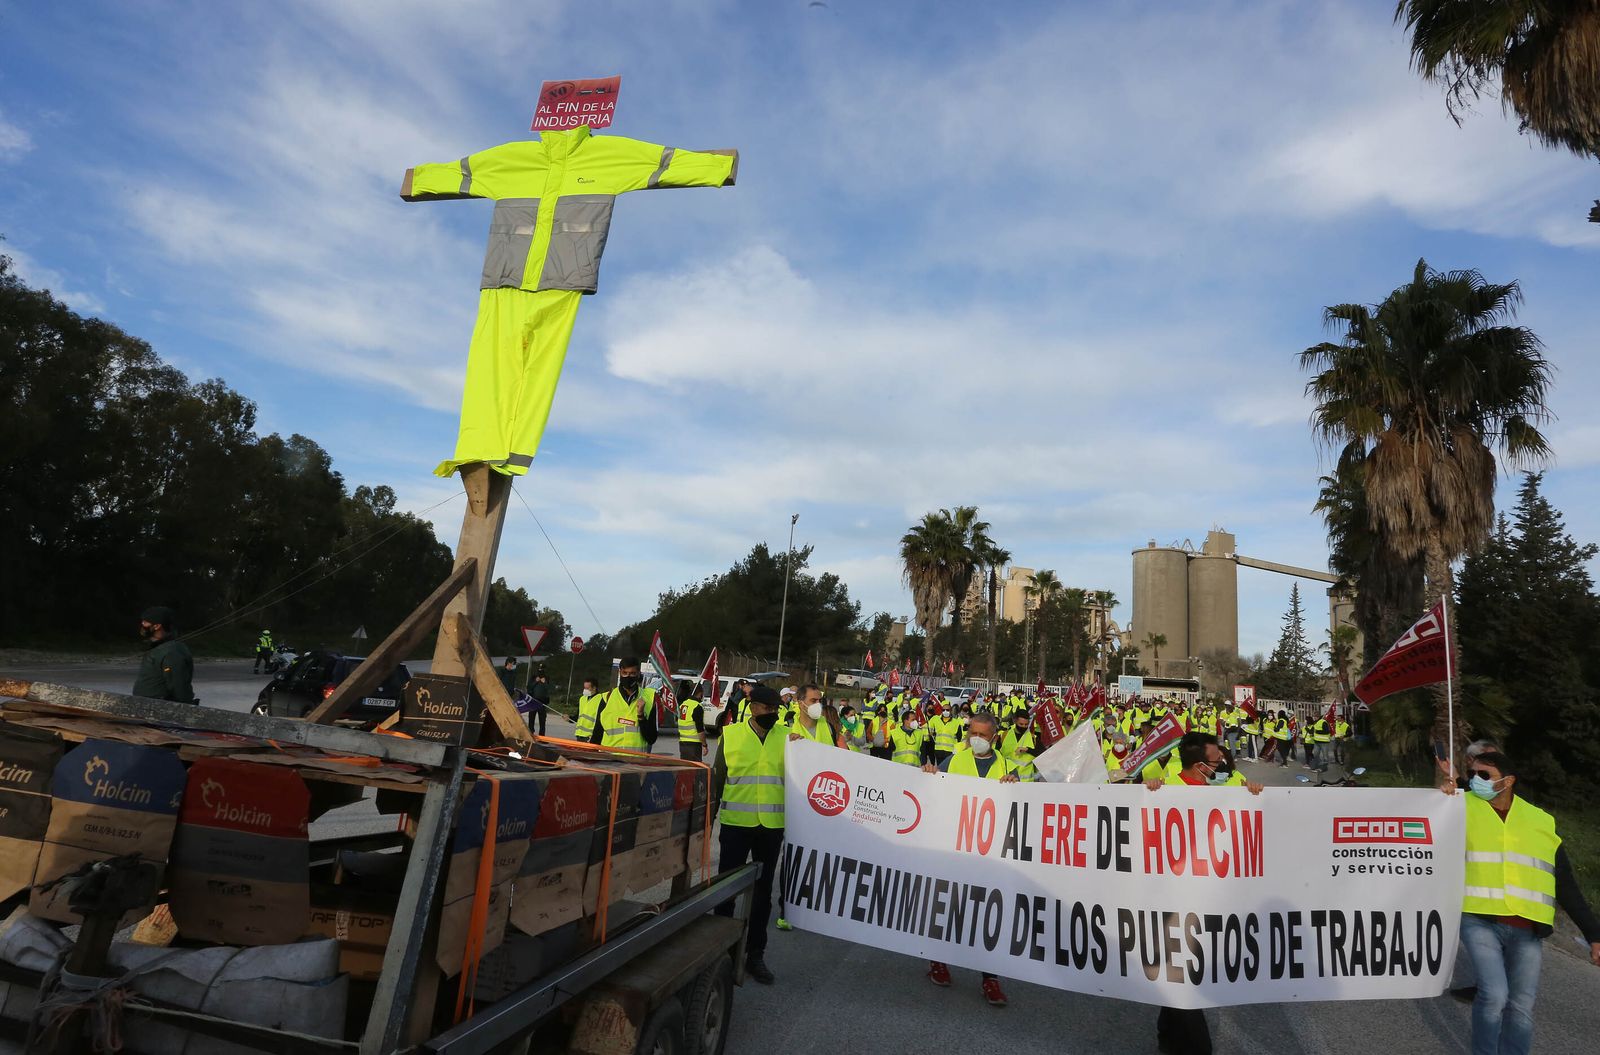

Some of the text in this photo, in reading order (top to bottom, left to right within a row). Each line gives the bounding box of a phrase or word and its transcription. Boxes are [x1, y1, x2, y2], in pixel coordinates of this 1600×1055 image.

[549, 87, 567, 97] NO
[556, 102, 579, 113] FIN
[582, 103, 598, 111] DE
[601, 102, 614, 110] LA
[535, 113, 610, 127] INDUSTRIA
[571, 641, 583, 649] STOP
[424, 701, 464, 716] Holcim
[93, 778, 152, 804] Holcim
[813, 776, 846, 800] UGT
[856, 786, 885, 804] FICA
[853, 805, 887, 817] Construcción
[855, 799, 879, 810] Industria,
[214, 801, 273, 828] Holcim
[561, 812, 588, 829] Holcim
[852, 811, 882, 823] Andalucía
[497, 817, 527, 838] olcim
[1338, 821, 1400, 838] CCOO
[955, 795, 1264, 878] NO AL ERE DE HOLCIM
[1332, 846, 1433, 860] construcción
[1331, 862, 1433, 877] y servicios
[785, 843, 1443, 986] MANTENIMIENTO DE LOS PUESTOS DE TRABAJO
